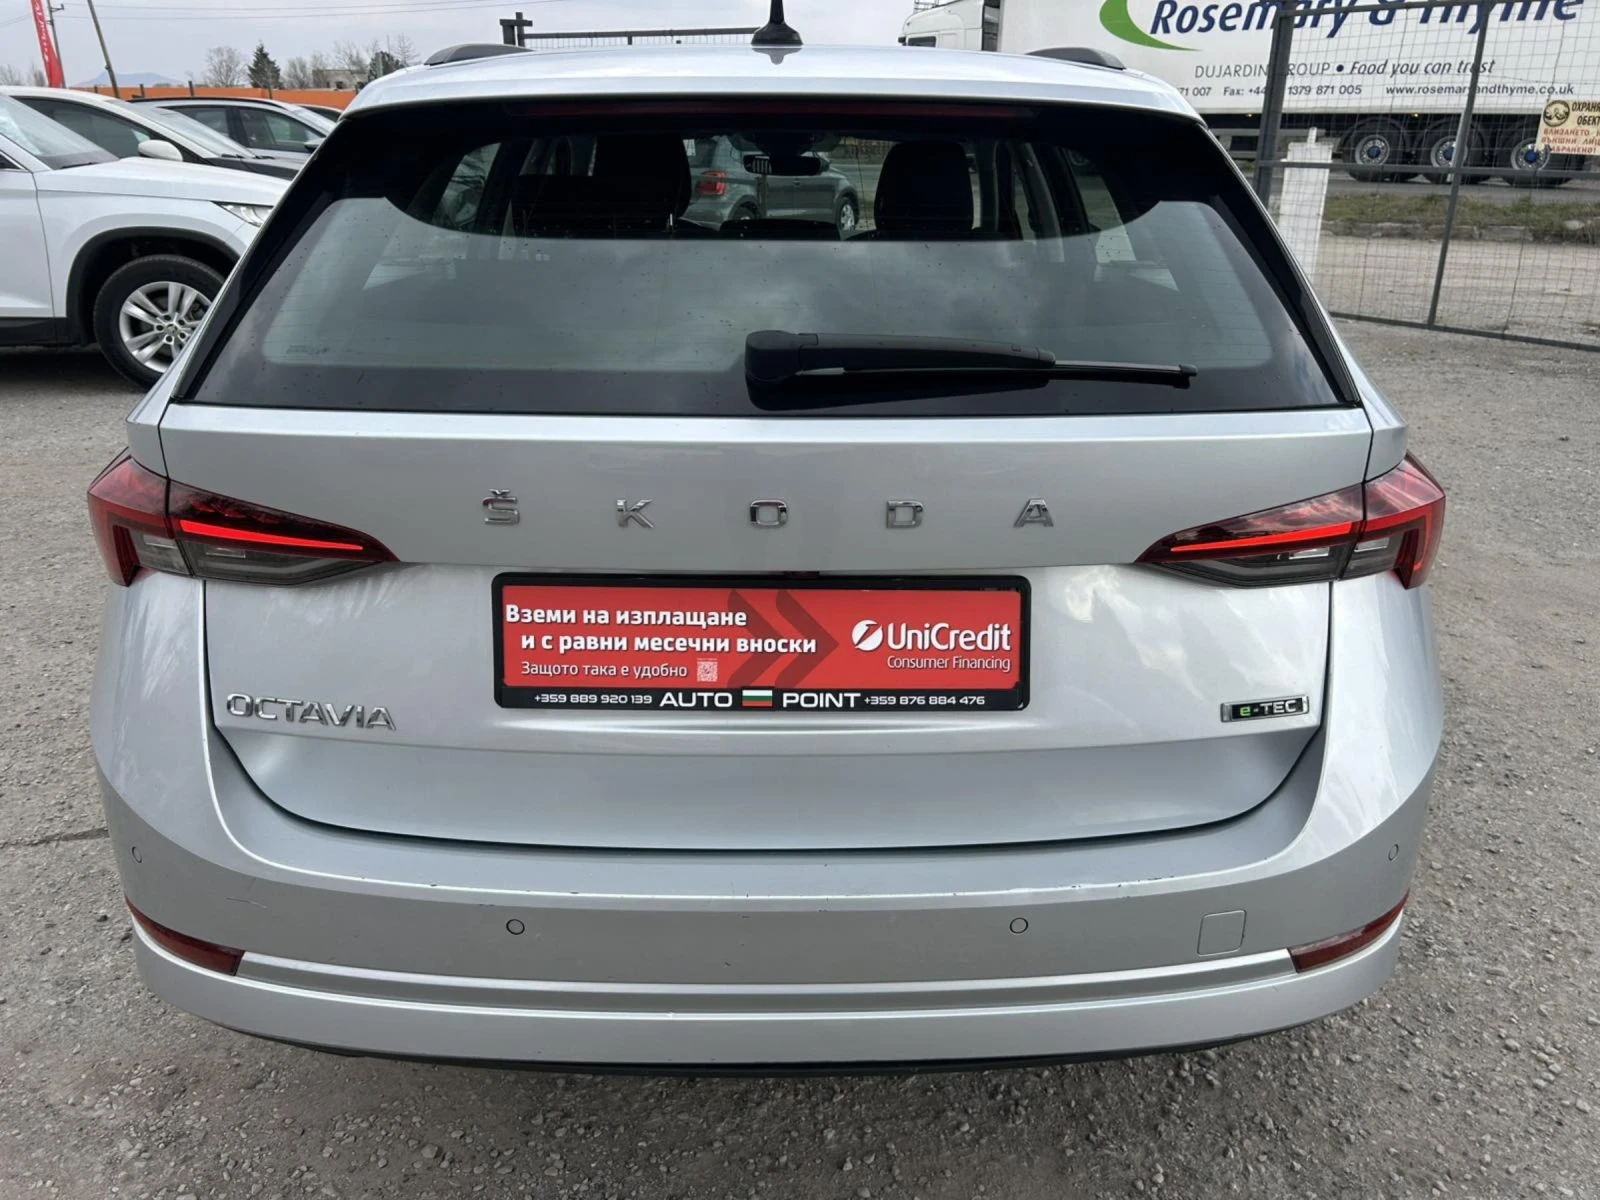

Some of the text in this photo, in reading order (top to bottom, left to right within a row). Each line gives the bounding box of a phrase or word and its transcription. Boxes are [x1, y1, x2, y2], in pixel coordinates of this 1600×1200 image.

[1194, 59, 1496, 78] DUJARDIN ROUP Food you can trst
[1192, 87, 1212, 96] 007
[1223, 86, 1245, 97] Fax:
[1288, 86, 1311, 95] 1379
[1316, 85, 1335, 95] 871
[1338, 84, 1362, 95] 005
[1386, 83, 1574, 97] www.rosemarandthyme.co.uk
[483, 488, 1055, 528] ŠKODA
[506, 604, 747, 629] Вземи на изплащане
[521, 635, 816, 654] и с равни месечни вноски
[887, 622, 1012, 651] UniCredit
[521, 661, 688, 679] Защото така е удобно
[887, 655, 1011, 673] Consumer Financing
[534, 691, 985, 708] +359 889 920 139 AUTO POINT +359 876 884 476
[226, 692, 397, 731] OCTAVIA
